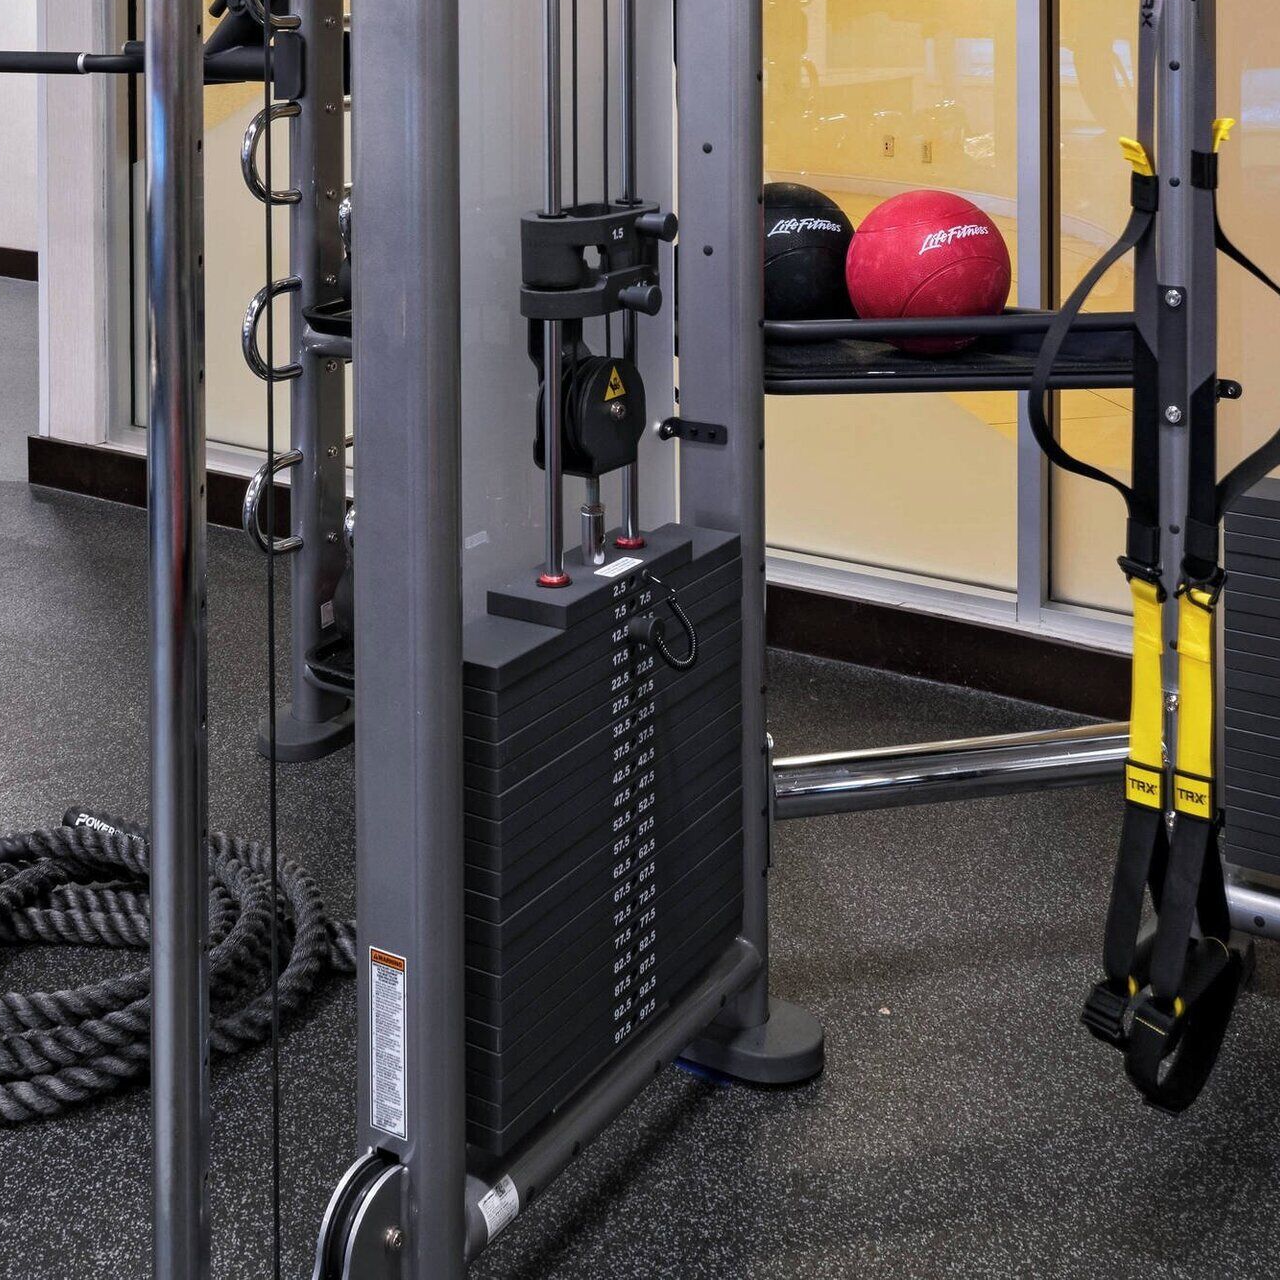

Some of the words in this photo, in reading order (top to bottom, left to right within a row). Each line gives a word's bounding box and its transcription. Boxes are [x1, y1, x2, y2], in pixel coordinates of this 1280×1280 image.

[612, 228, 623, 239] 1.5
[768, 219, 800, 237] Life
[798, 218, 841, 233] Fitness
[919, 230, 949, 255] Life
[946, 224, 988, 245] Fitness
[614, 582, 625, 597] 2.5
[615, 605, 626, 619] 7.5
[640, 591, 650, 605] 7.5
[612, 626, 629, 642] 12.5
[612, 672, 628, 691] 22.5
[638, 657, 653, 674] 22.5
[613, 649, 628, 665] 17.5
[613, 696, 628, 714] 27.5
[638, 680, 653, 697] 27.5
[614, 719, 630, 737] 32.5
[639, 702, 654, 720] 32.5
[614, 742, 629, 760] 37.5
[639, 725, 653, 743] 37.5
[613, 765, 630, 783] 42.5
[638, 748, 654, 765] 42.5
[614, 789, 630, 806] 47.5
[639, 771, 654, 788] 47.5
[1129, 777, 1155, 795] TRX
[1177, 788, 1204, 805] TRX
[614, 811, 630, 831] 52.5
[639, 793, 654, 812] 52.5
[614, 835, 629, 854] 57.5
[639, 817, 654, 835] 57.5
[614, 858, 630, 878] 62.5
[639, 839, 654, 858] 62.5
[614, 882, 630, 902] 67.5
[640, 862, 654, 881] 67.5
[614, 905, 631, 925] 72.5
[640, 884, 655, 904] 72.5
[615, 929, 630, 949] 77.5
[640, 908, 655, 927] 77.5
[614, 952, 631, 973] 82.5
[640, 930, 655, 954] 82.5
[615, 975, 630, 996] 87.5
[640, 953, 655, 974] 87.5
[615, 998, 631, 1022] 92.5
[640, 976, 656, 997] 92.5
[615, 1021, 631, 1043] 97.5
[640, 999, 655, 1019] 97.5
